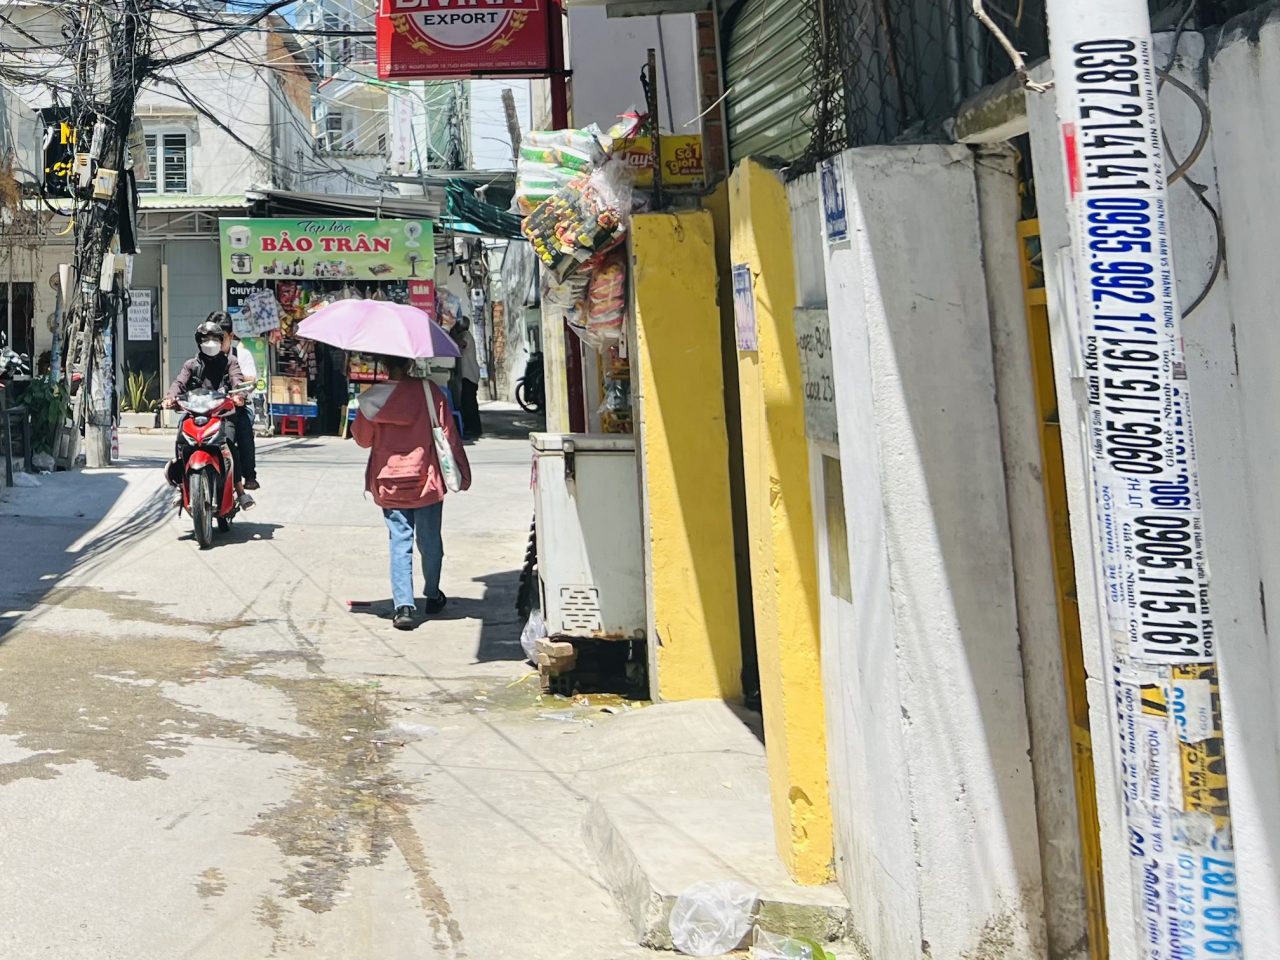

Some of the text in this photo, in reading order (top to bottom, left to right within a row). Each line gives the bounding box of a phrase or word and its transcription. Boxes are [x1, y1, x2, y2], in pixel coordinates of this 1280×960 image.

[424, 11, 498, 26] EXPORT
[1073, 38, 1151, 191] 0387.21.41.41
[261, 232, 392, 253] BẢO TRÂN
[1084, 336, 1098, 371] Khoa
[1101, 338, 1163, 475] 0905.115.161
[1103, 513, 1115, 554] NHANH
[1125, 571, 1138, 609] Nhanh
[1133, 515, 1199, 657] 0905.115.161
[1201, 619, 1214, 658] Khoa
[1149, 759, 1161, 801] NHANH
